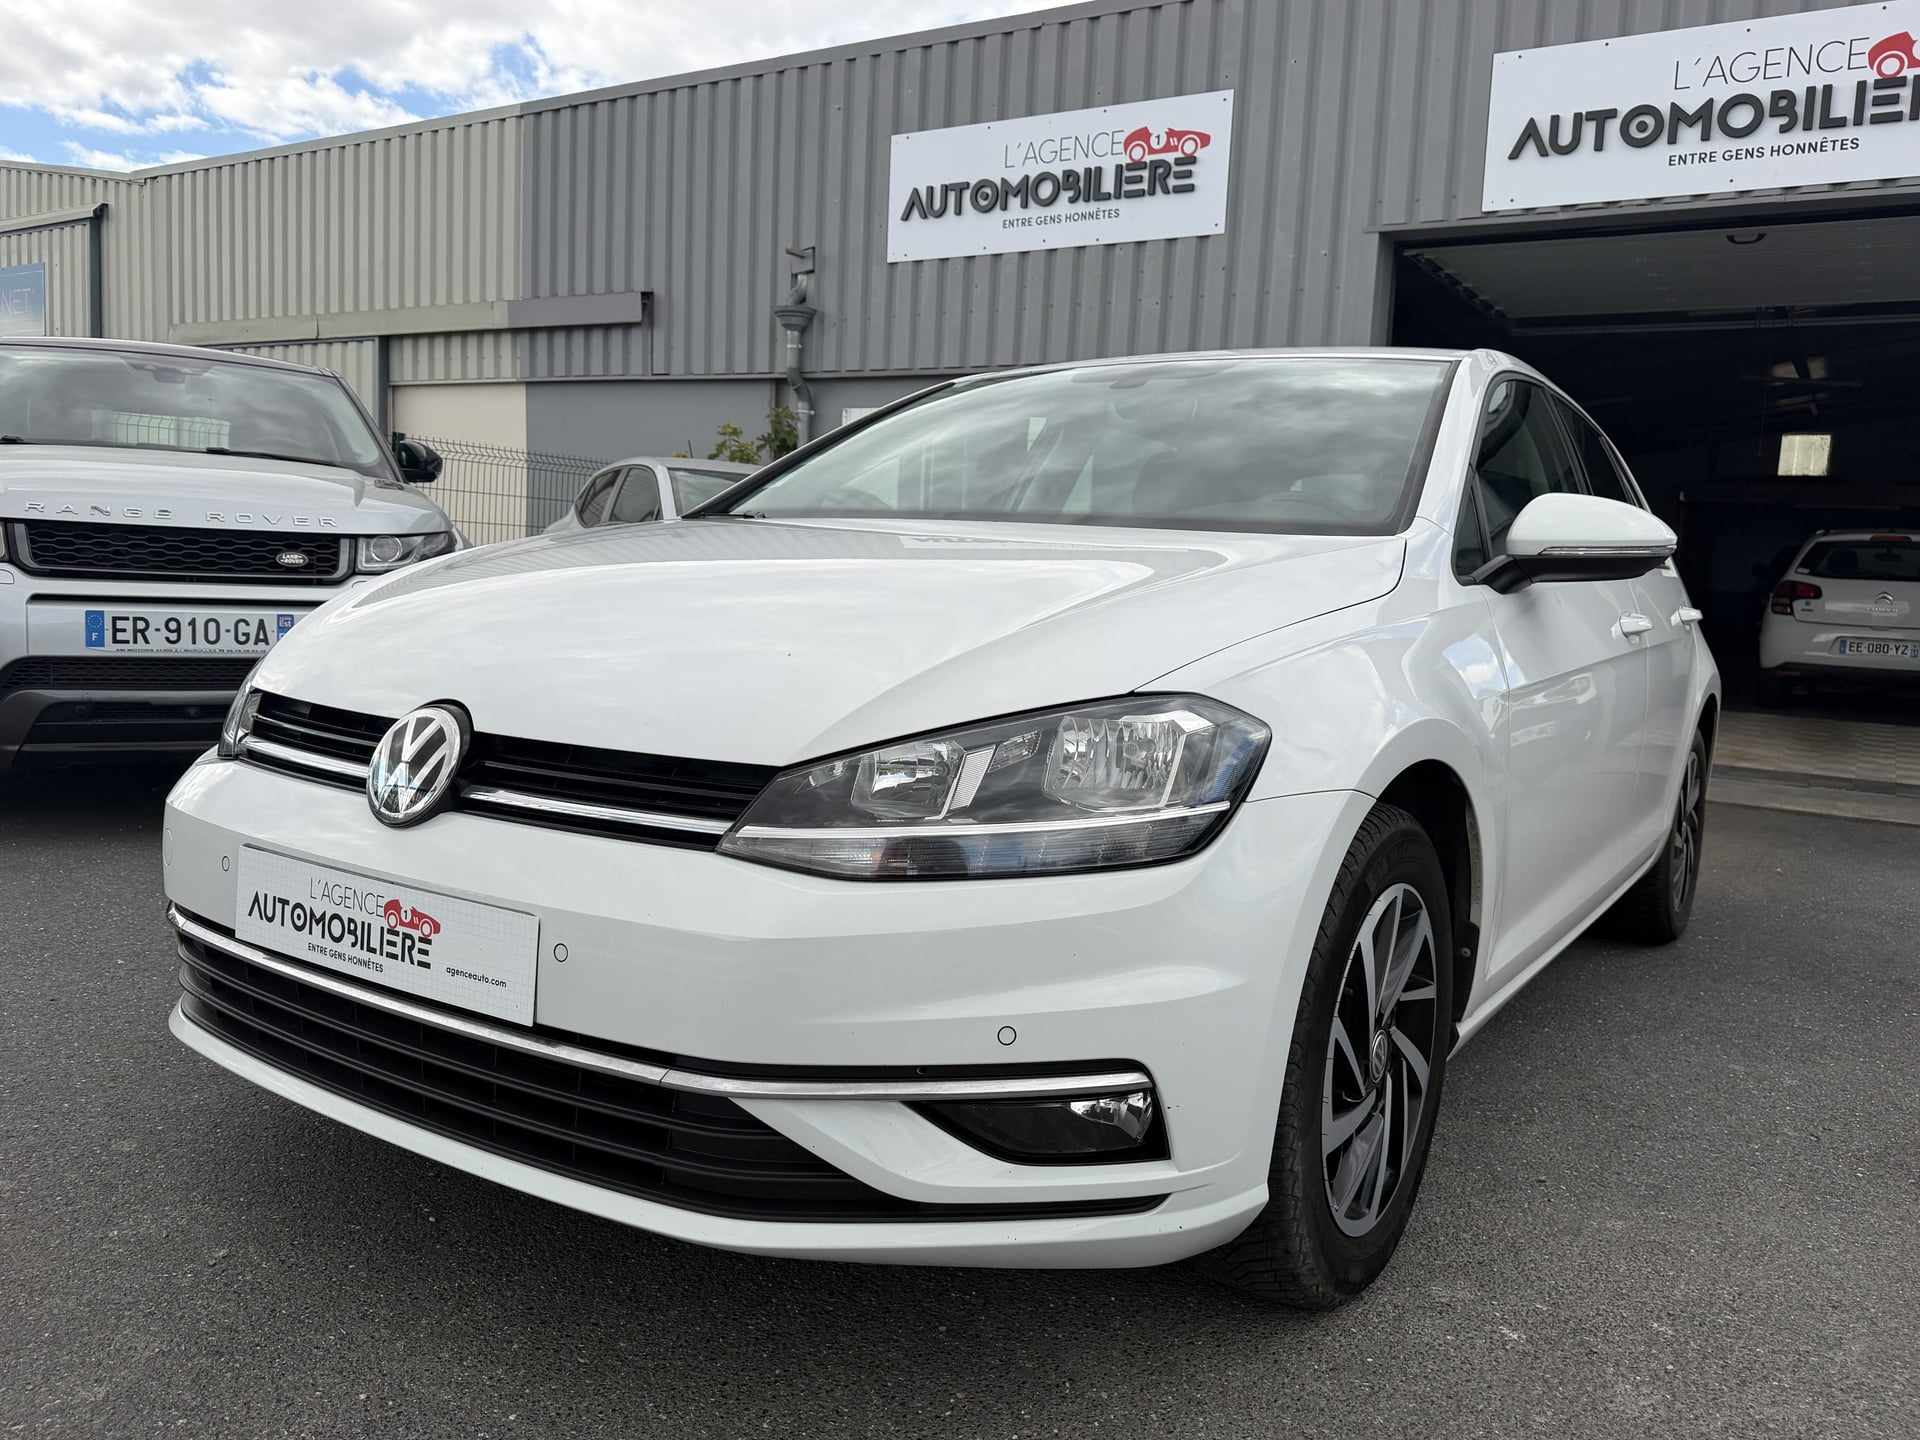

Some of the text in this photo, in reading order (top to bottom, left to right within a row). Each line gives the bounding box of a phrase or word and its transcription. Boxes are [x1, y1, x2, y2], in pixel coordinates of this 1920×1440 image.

[1674, 37, 1870, 91] L'AGENCE
[1004, 129, 1125, 168] L'AGENCE
[1668, 137, 1860, 167] ENTRE GENS HONNÊTES
[900, 156, 1197, 221] AUTOMOBILIERE
[1002, 207, 1120, 229] ENTRE GENS HONNÊTES
[24, 502, 337, 527] RANGE ROVER
[92, 632, 98, 641] F
[111, 616, 270, 646] ER-910-GA
[1848, 642, 1909, 655] EE-080-YZ
[310, 877, 385, 918] L'AGENCE
[248, 890, 433, 970] AUTOMOBILIERE
[308, 942, 384, 973] ENTRE GENS HONNÊTES
[446, 966, 507, 989] agenceauto.com
